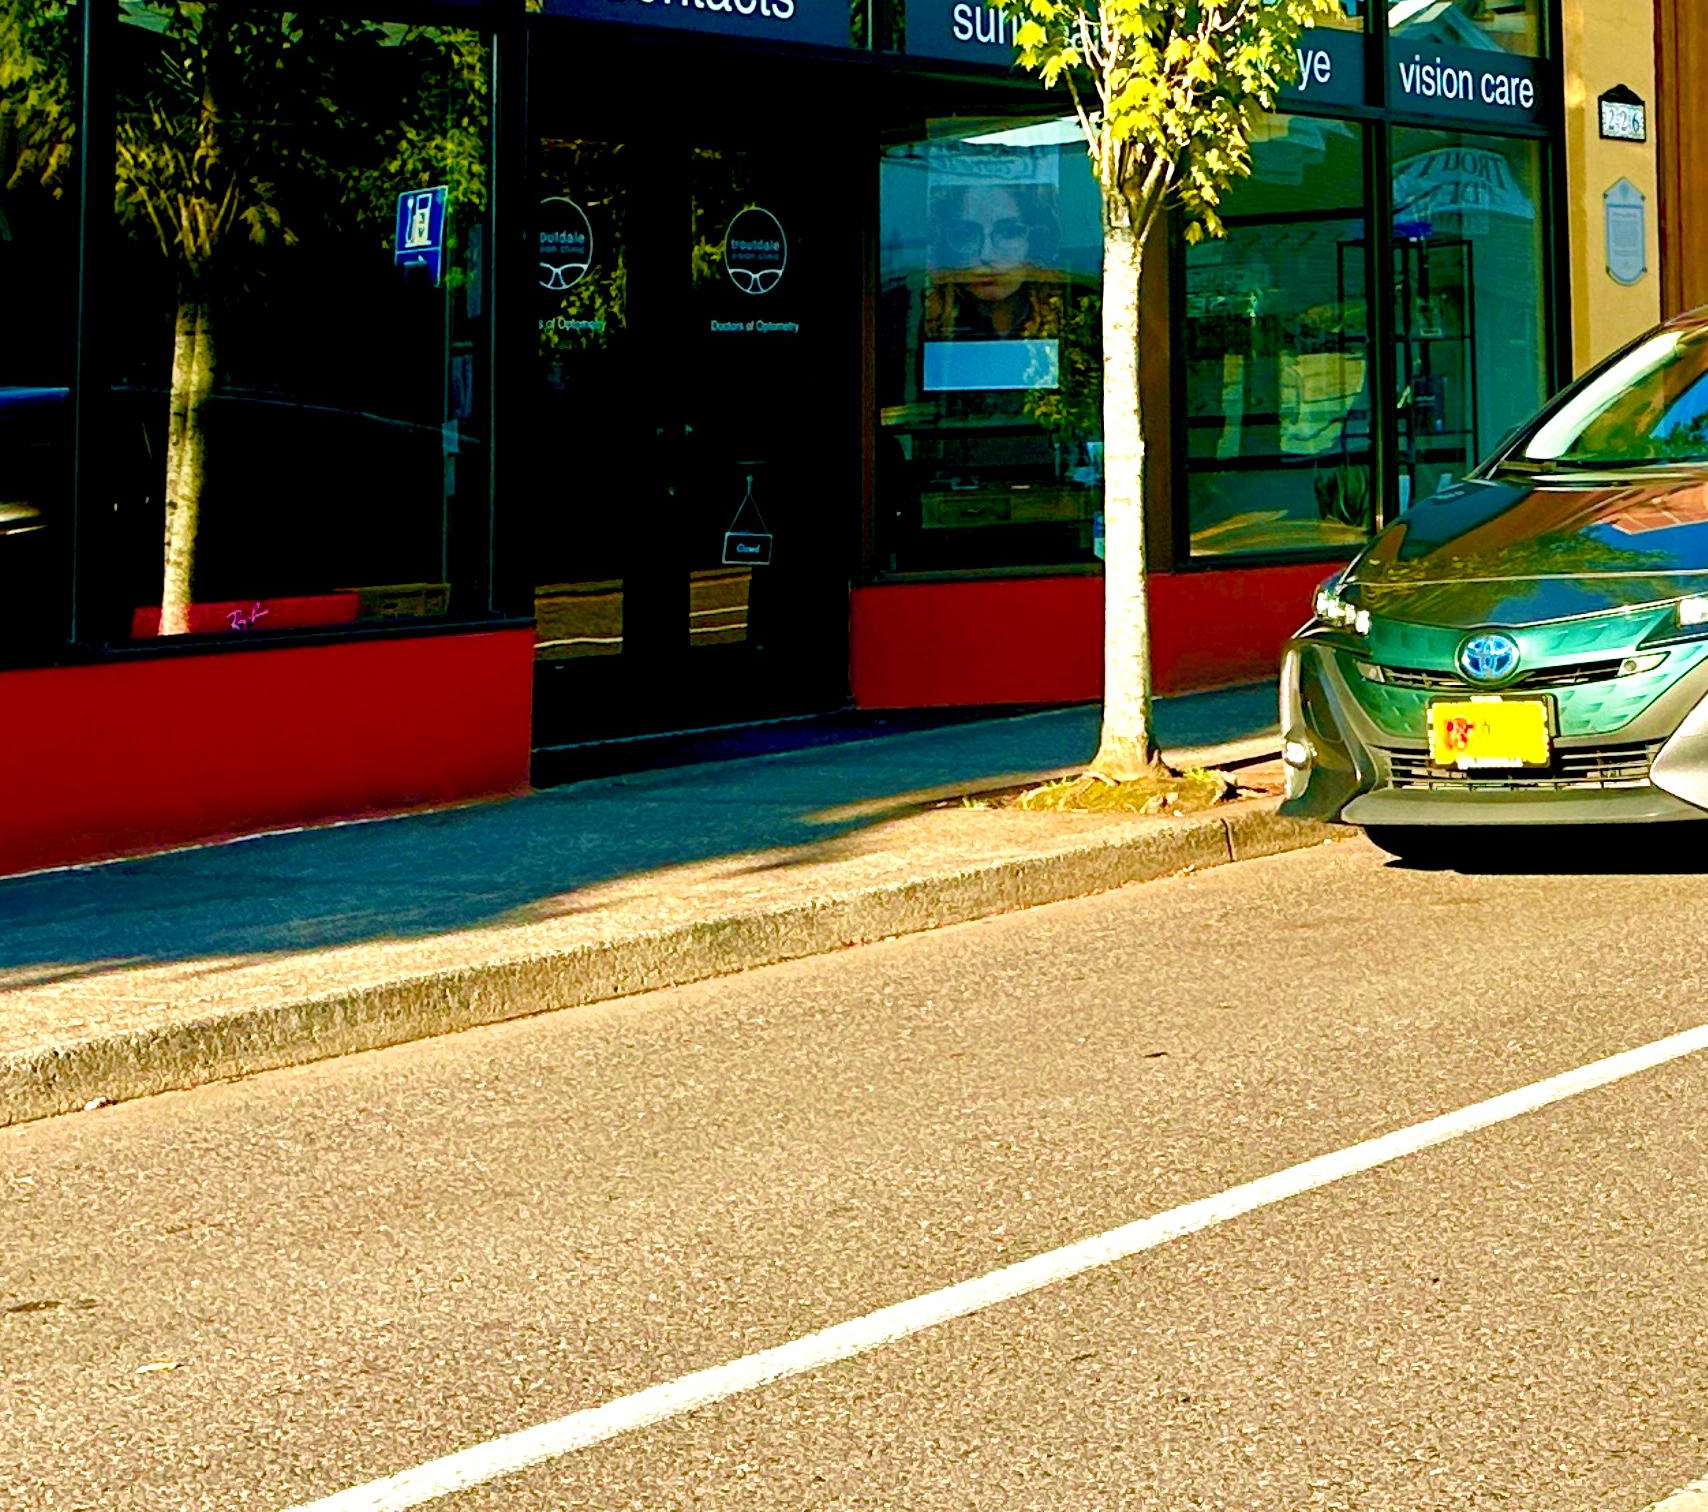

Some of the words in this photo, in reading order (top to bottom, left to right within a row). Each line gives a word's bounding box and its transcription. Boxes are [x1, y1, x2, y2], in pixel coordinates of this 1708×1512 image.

[1399, 55, 1475, 101] vision
[1480, 72, 1535, 109] care
[710, 319, 745, 332] Doctors
[745, 319, 755, 332] of
[756, 319, 800, 335] Optometry
